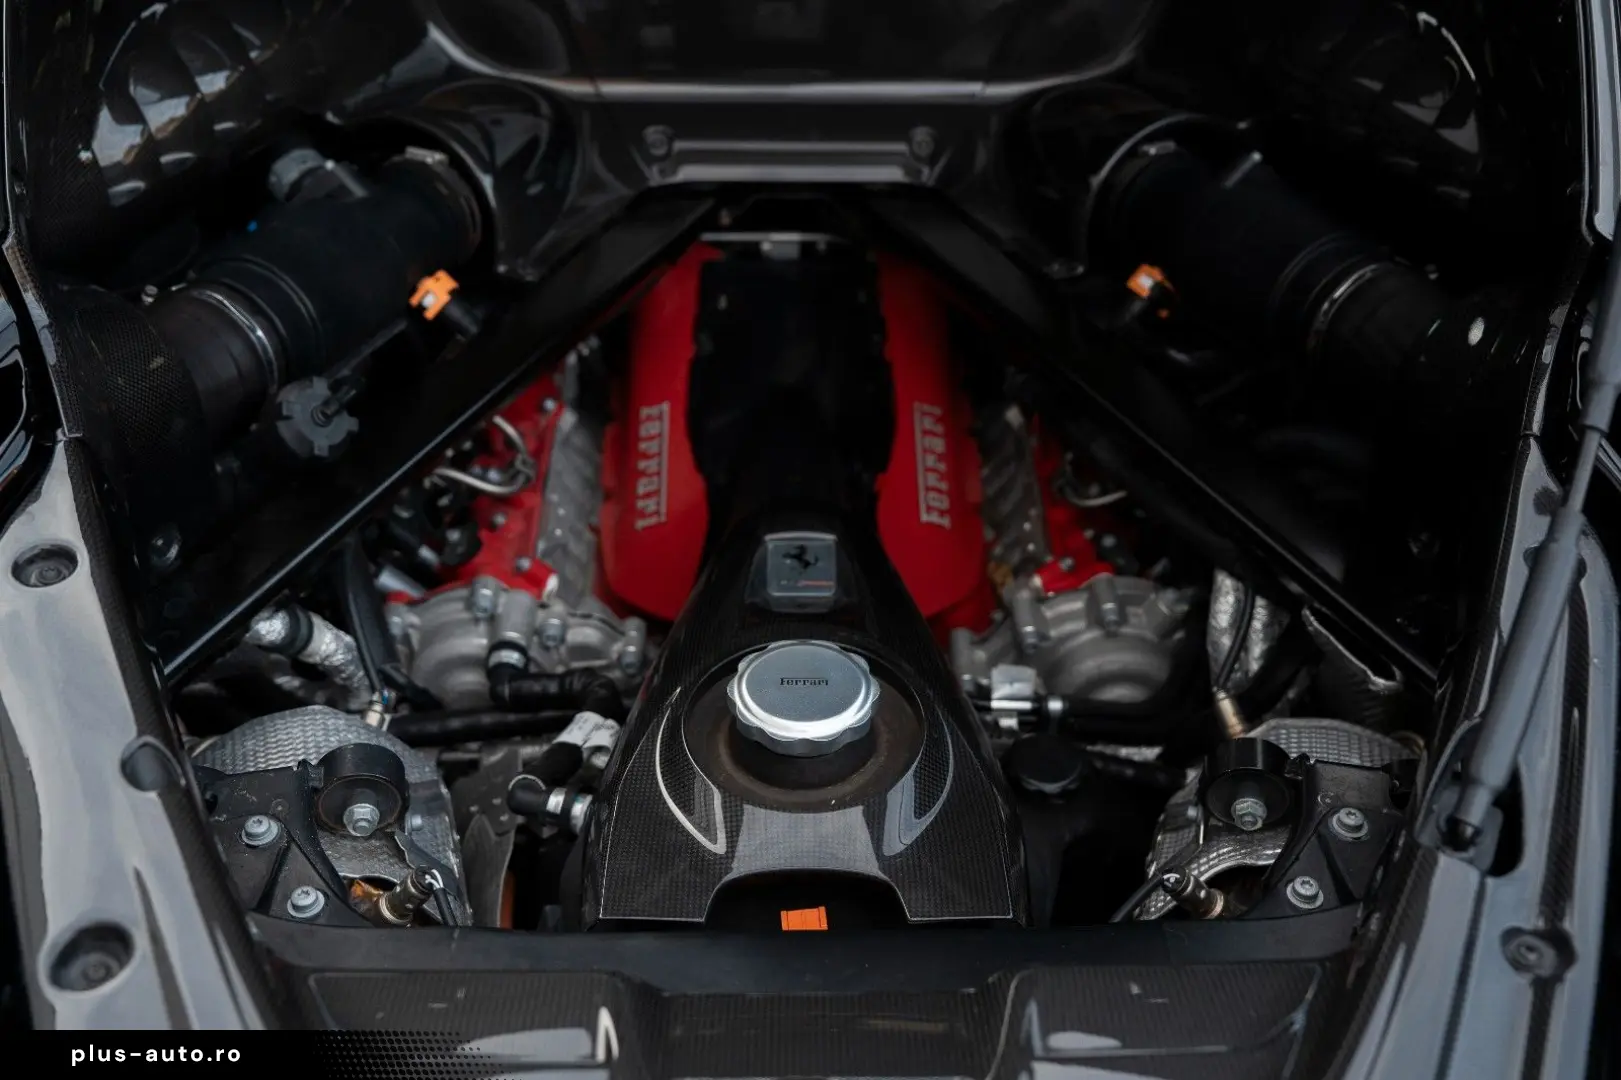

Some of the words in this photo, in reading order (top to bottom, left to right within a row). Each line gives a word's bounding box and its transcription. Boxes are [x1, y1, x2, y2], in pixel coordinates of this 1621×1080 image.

[635, 401, 669, 530] Ferrari
[913, 401, 951, 529] Ferrari
[780, 677, 829, 686] Ferrari
